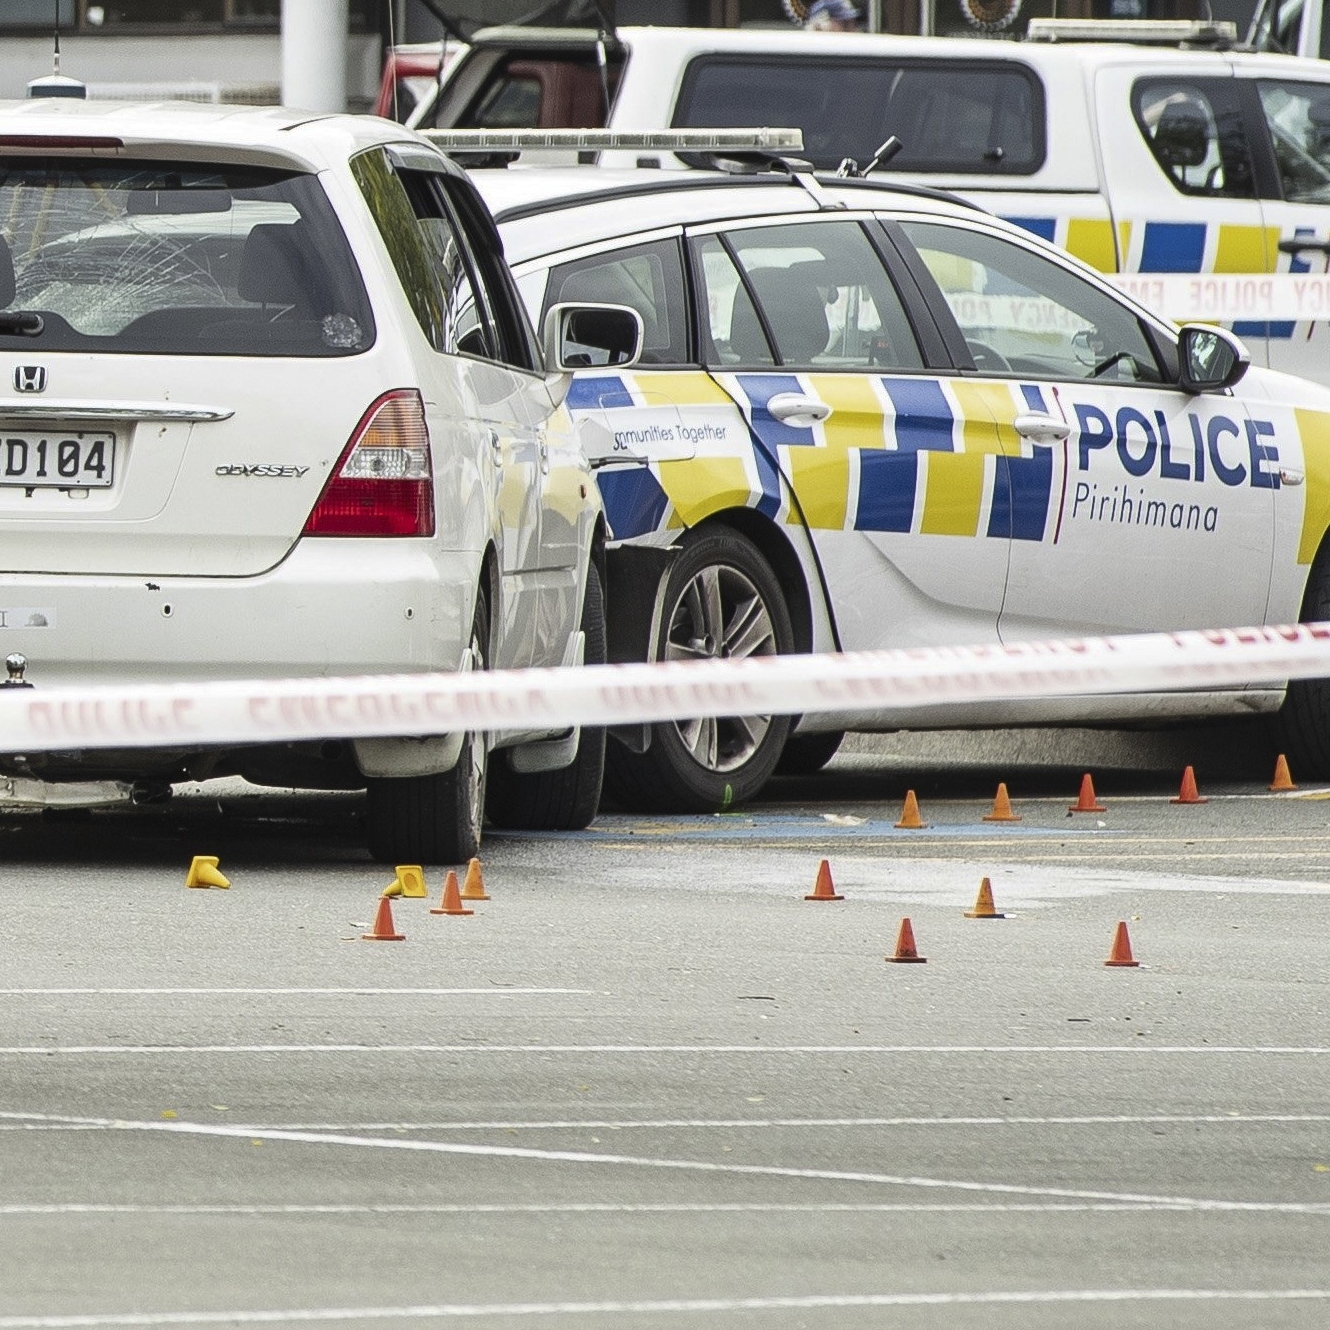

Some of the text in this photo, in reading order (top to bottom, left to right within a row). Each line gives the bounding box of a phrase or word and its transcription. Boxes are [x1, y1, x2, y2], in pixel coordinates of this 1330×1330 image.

[675, 424, 727, 444] Together
[1073, 403, 1281, 489] POLICE
[215, 463, 310, 478] ODYSSEY
[1072, 482, 1219, 532] Pirihimana
